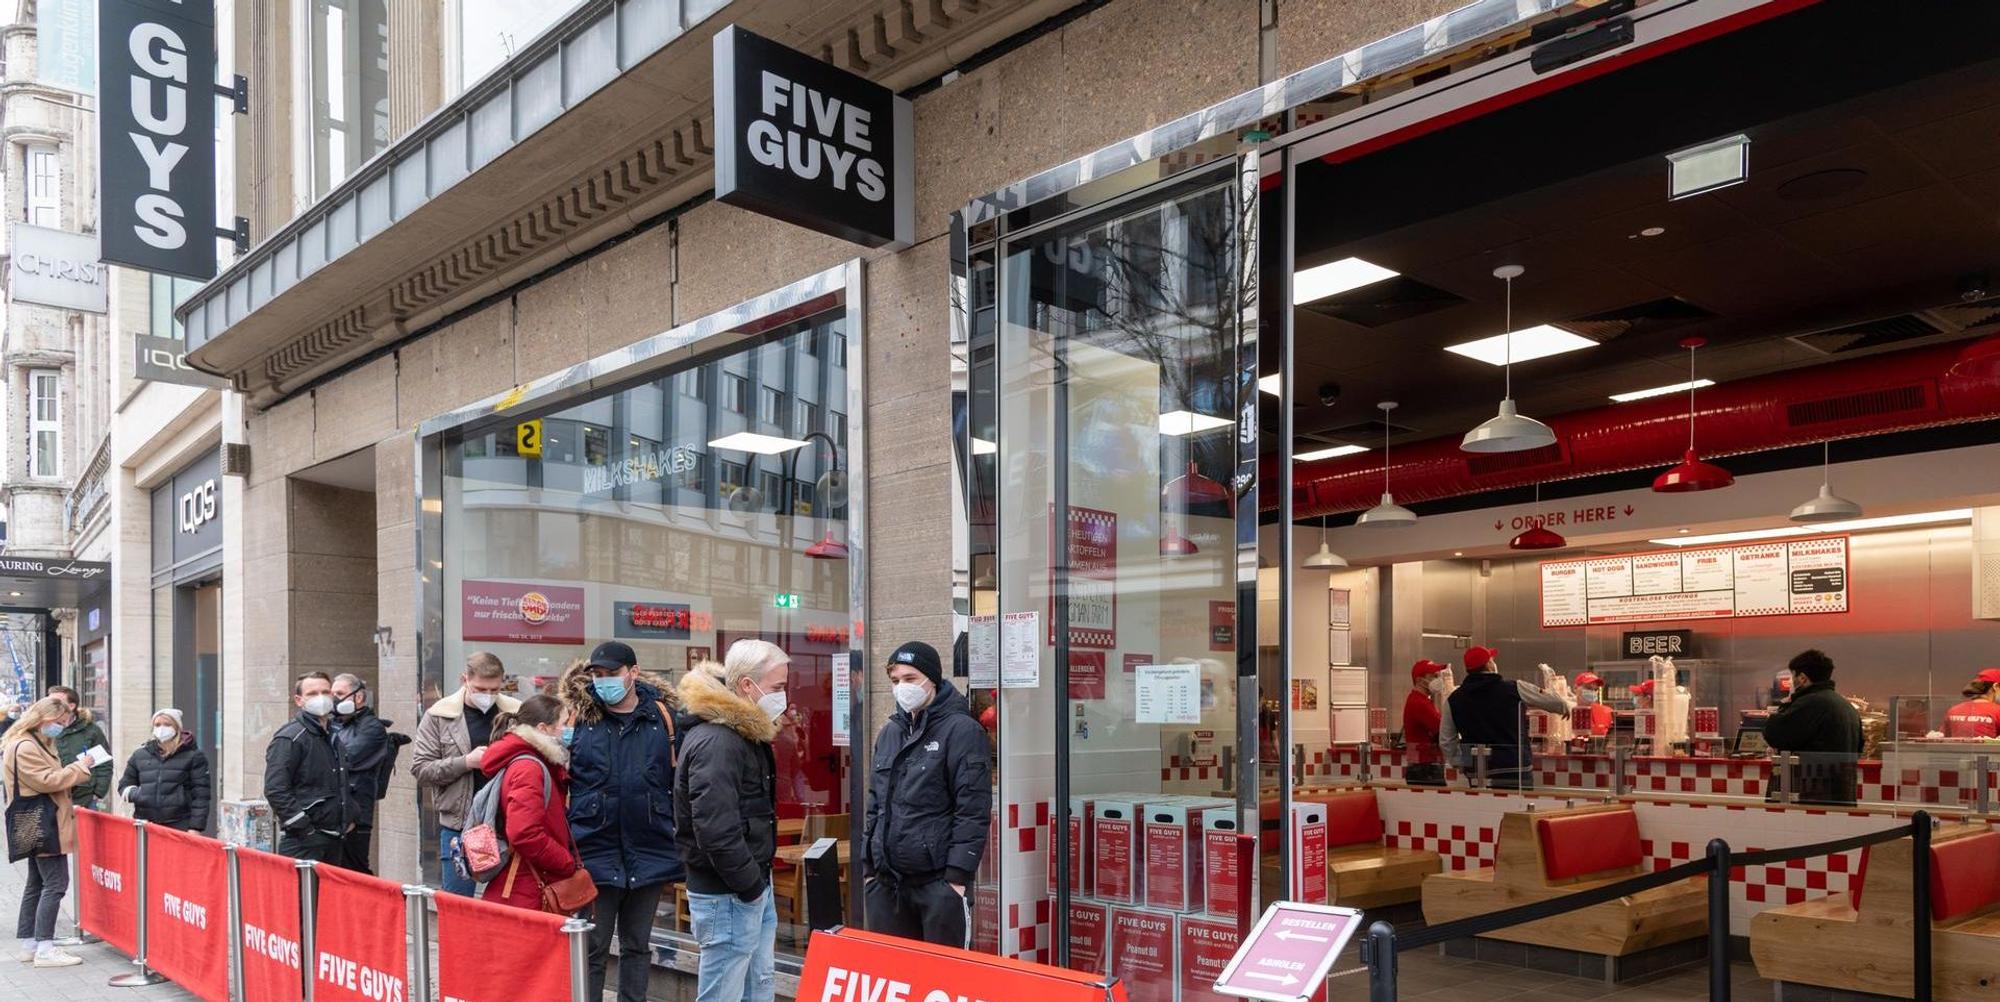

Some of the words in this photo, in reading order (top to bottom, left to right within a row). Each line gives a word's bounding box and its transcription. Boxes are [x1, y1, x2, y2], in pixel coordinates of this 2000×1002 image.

[762, 70, 872, 152] FIVE
[129, 22, 189, 250] GUYS
[747, 119, 886, 202] GUYS
[16, 254, 103, 285] CHRIST
[144, 349, 194, 370] IQ
[583, 442, 697, 494] MILKSHAKES
[179, 479, 216, 534] IQOS
[1511, 512, 1566, 530] ORDER
[1573, 506, 1616, 523] HERE
[1068, 544, 1106, 557] RTOFFELN
[1792, 547, 1842, 557] MILKSHAKES
[47, 560, 105, 579] Lounge
[1635, 560, 1679, 569] SANDWICHES
[1629, 636, 1682, 655] BEER
[1163, 829, 1180, 837] GUYS
[1223, 835, 1237, 843] GUY
[91, 864, 104, 886] FIVE
[104, 869, 122, 893] GUYS
[163, 892, 181, 919] FIVE
[183, 900, 207, 930] GUYS
[1076, 910, 1100, 921] GUYS
[1117, 916, 1138, 927] FIVE
[1140, 919, 1166, 931] GUYS
[1281, 917, 1336, 931] BESTELLEN
[1187, 926, 1210, 938] FIVE
[1212, 930, 1238, 943] GUYS
[244, 923, 267, 956] FIVE
[268, 933, 299, 969] GUYS
[1126, 943, 1148, 956] Peanut
[1149, 946, 1158, 957] Oil
[1196, 955, 1221, 968] Peanut
[319, 952, 357, 992] FIVE
[360, 966, 403, 1002] GUYS
